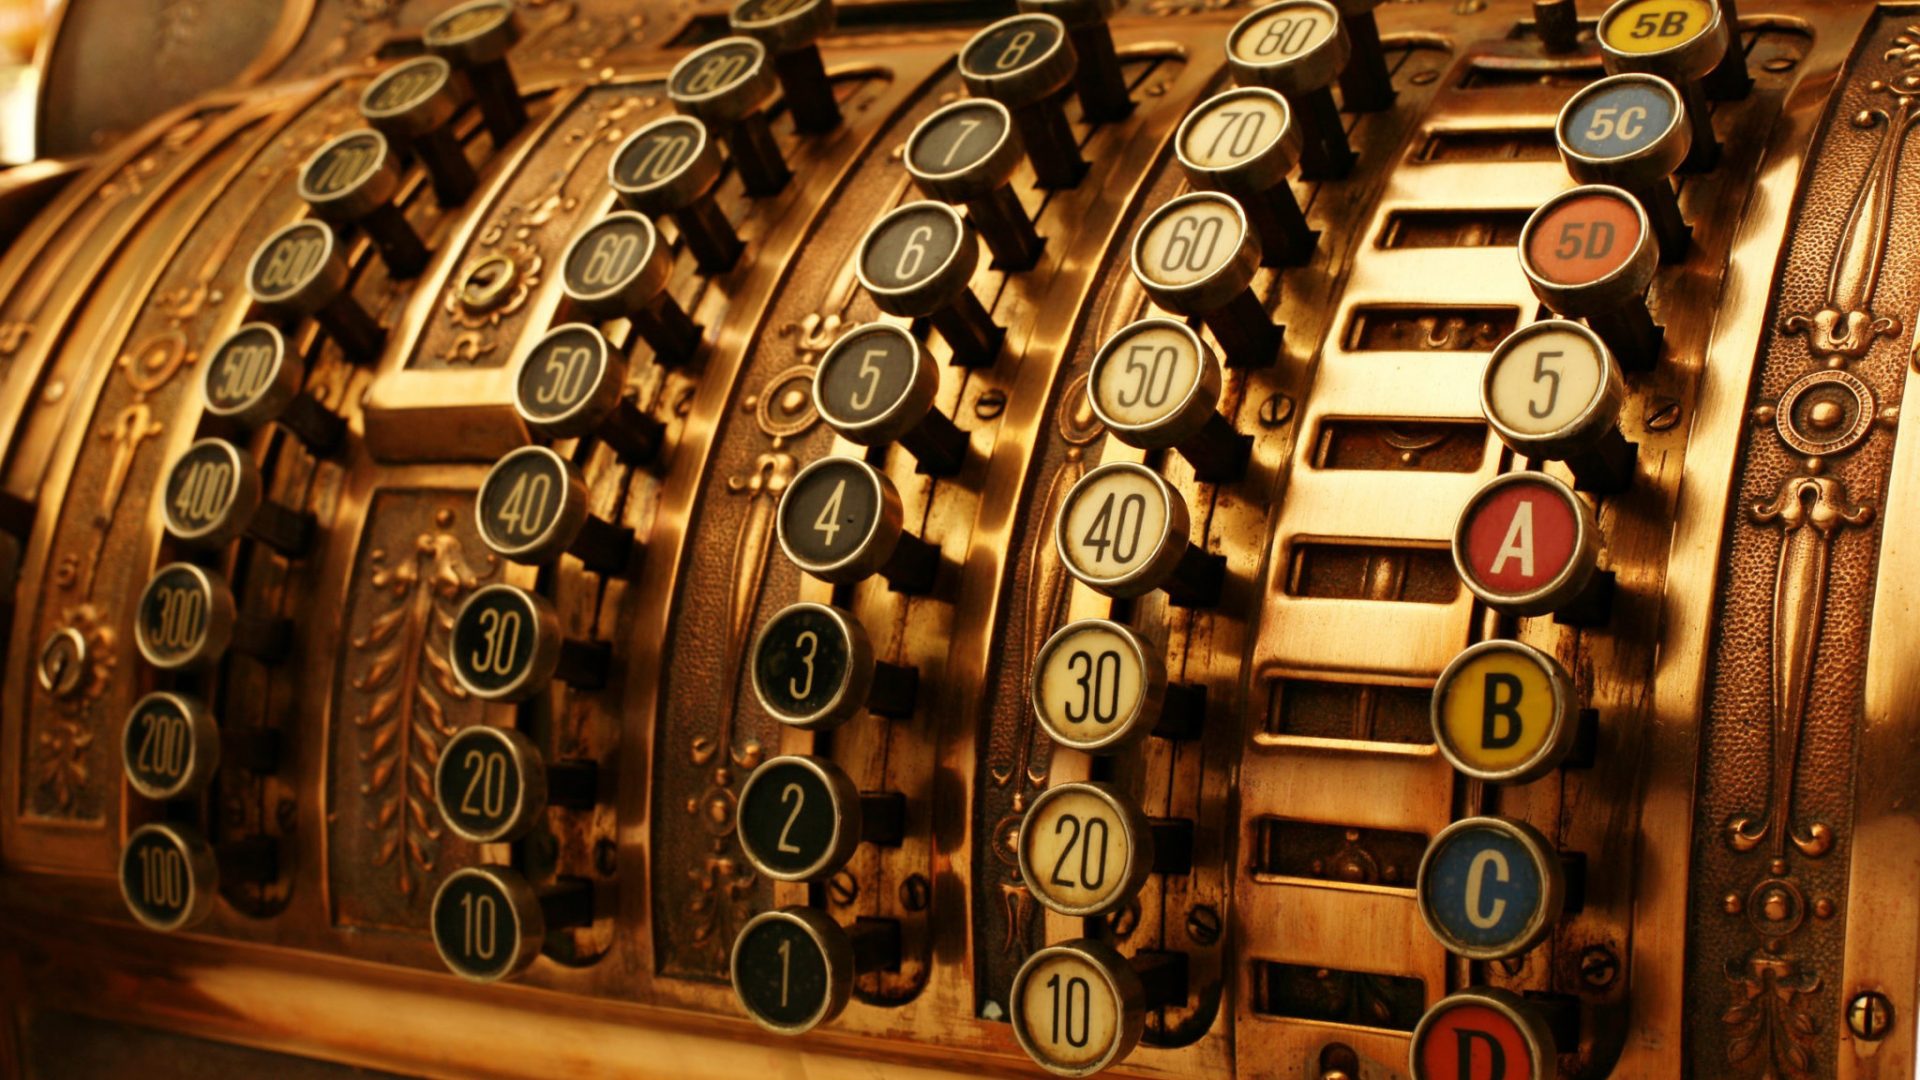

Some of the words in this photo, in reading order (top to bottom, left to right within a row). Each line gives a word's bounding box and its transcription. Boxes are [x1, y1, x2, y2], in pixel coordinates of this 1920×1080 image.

[996, 31, 1035, 69] 8
[1255, 18, 1317, 56] 80
[1630, 10, 1690, 40] 5B
[687, 55, 742, 92] 80
[942, 120, 980, 167] 7
[1207, 111, 1266, 158] 70
[1585, 105, 1647, 142] 5C
[315, 146, 379, 190] 700
[632, 136, 690, 180] 70
[262, 237, 323, 288] 600
[583, 234, 637, 285] 60
[895, 226, 932, 280] 6
[1161, 217, 1223, 272] 60
[1554, 221, 1615, 260] 5D
[216, 346, 272, 398] 500
[537, 347, 589, 404] 50
[851, 350, 888, 410] 5
[1118, 345, 1178, 408] 50
[1528, 351, 1564, 419] 5
[175, 464, 230, 519] 400
[498, 473, 552, 535] 40
[814, 480, 846, 546] 4
[1083, 492, 1146, 563] 40
[1490, 501, 1534, 577] A
[152, 586, 201, 648] 300
[472, 608, 520, 675] 30
[790, 631, 818, 699] 3
[1064, 650, 1121, 725] 30
[1480, 672, 1524, 750] B
[138, 715, 185, 777] 200
[461, 750, 506, 818] 20
[777, 783, 805, 854] 2
[139, 847, 181, 909] 100
[1052, 814, 1109, 890] 20
[1464, 848, 1510, 929] C
[460, 893, 497, 960] 10
[777, 940, 791, 1007] 1
[1047, 973, 1091, 1048] 10
[1452, 1027, 1507, 1080] D
